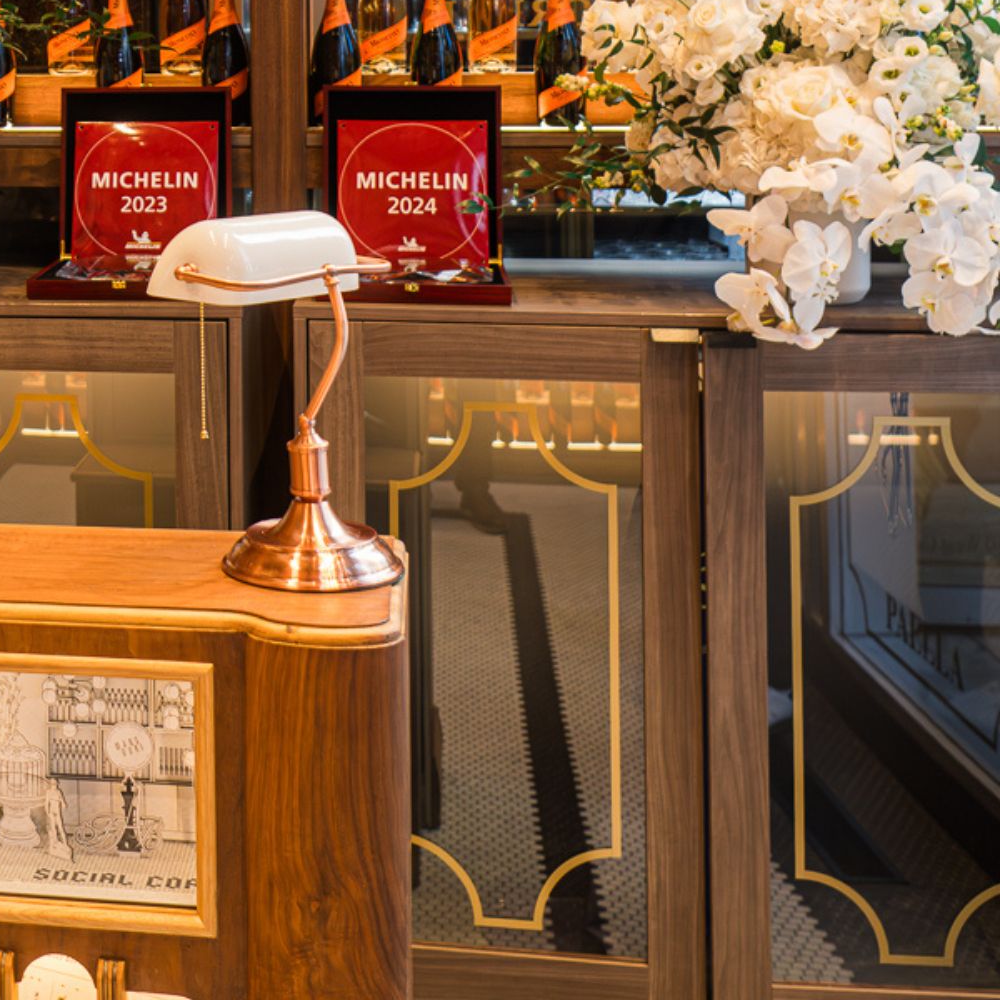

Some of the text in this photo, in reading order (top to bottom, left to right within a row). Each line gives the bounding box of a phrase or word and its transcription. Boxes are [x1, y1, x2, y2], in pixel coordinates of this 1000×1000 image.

[91, 171, 198, 188] MICHELIN
[356, 170, 468, 190] MICHELIN
[120, 195, 168, 213] 2023
[387, 196, 438, 215] 2024
[33, 867, 133, 887] SOCIAL
